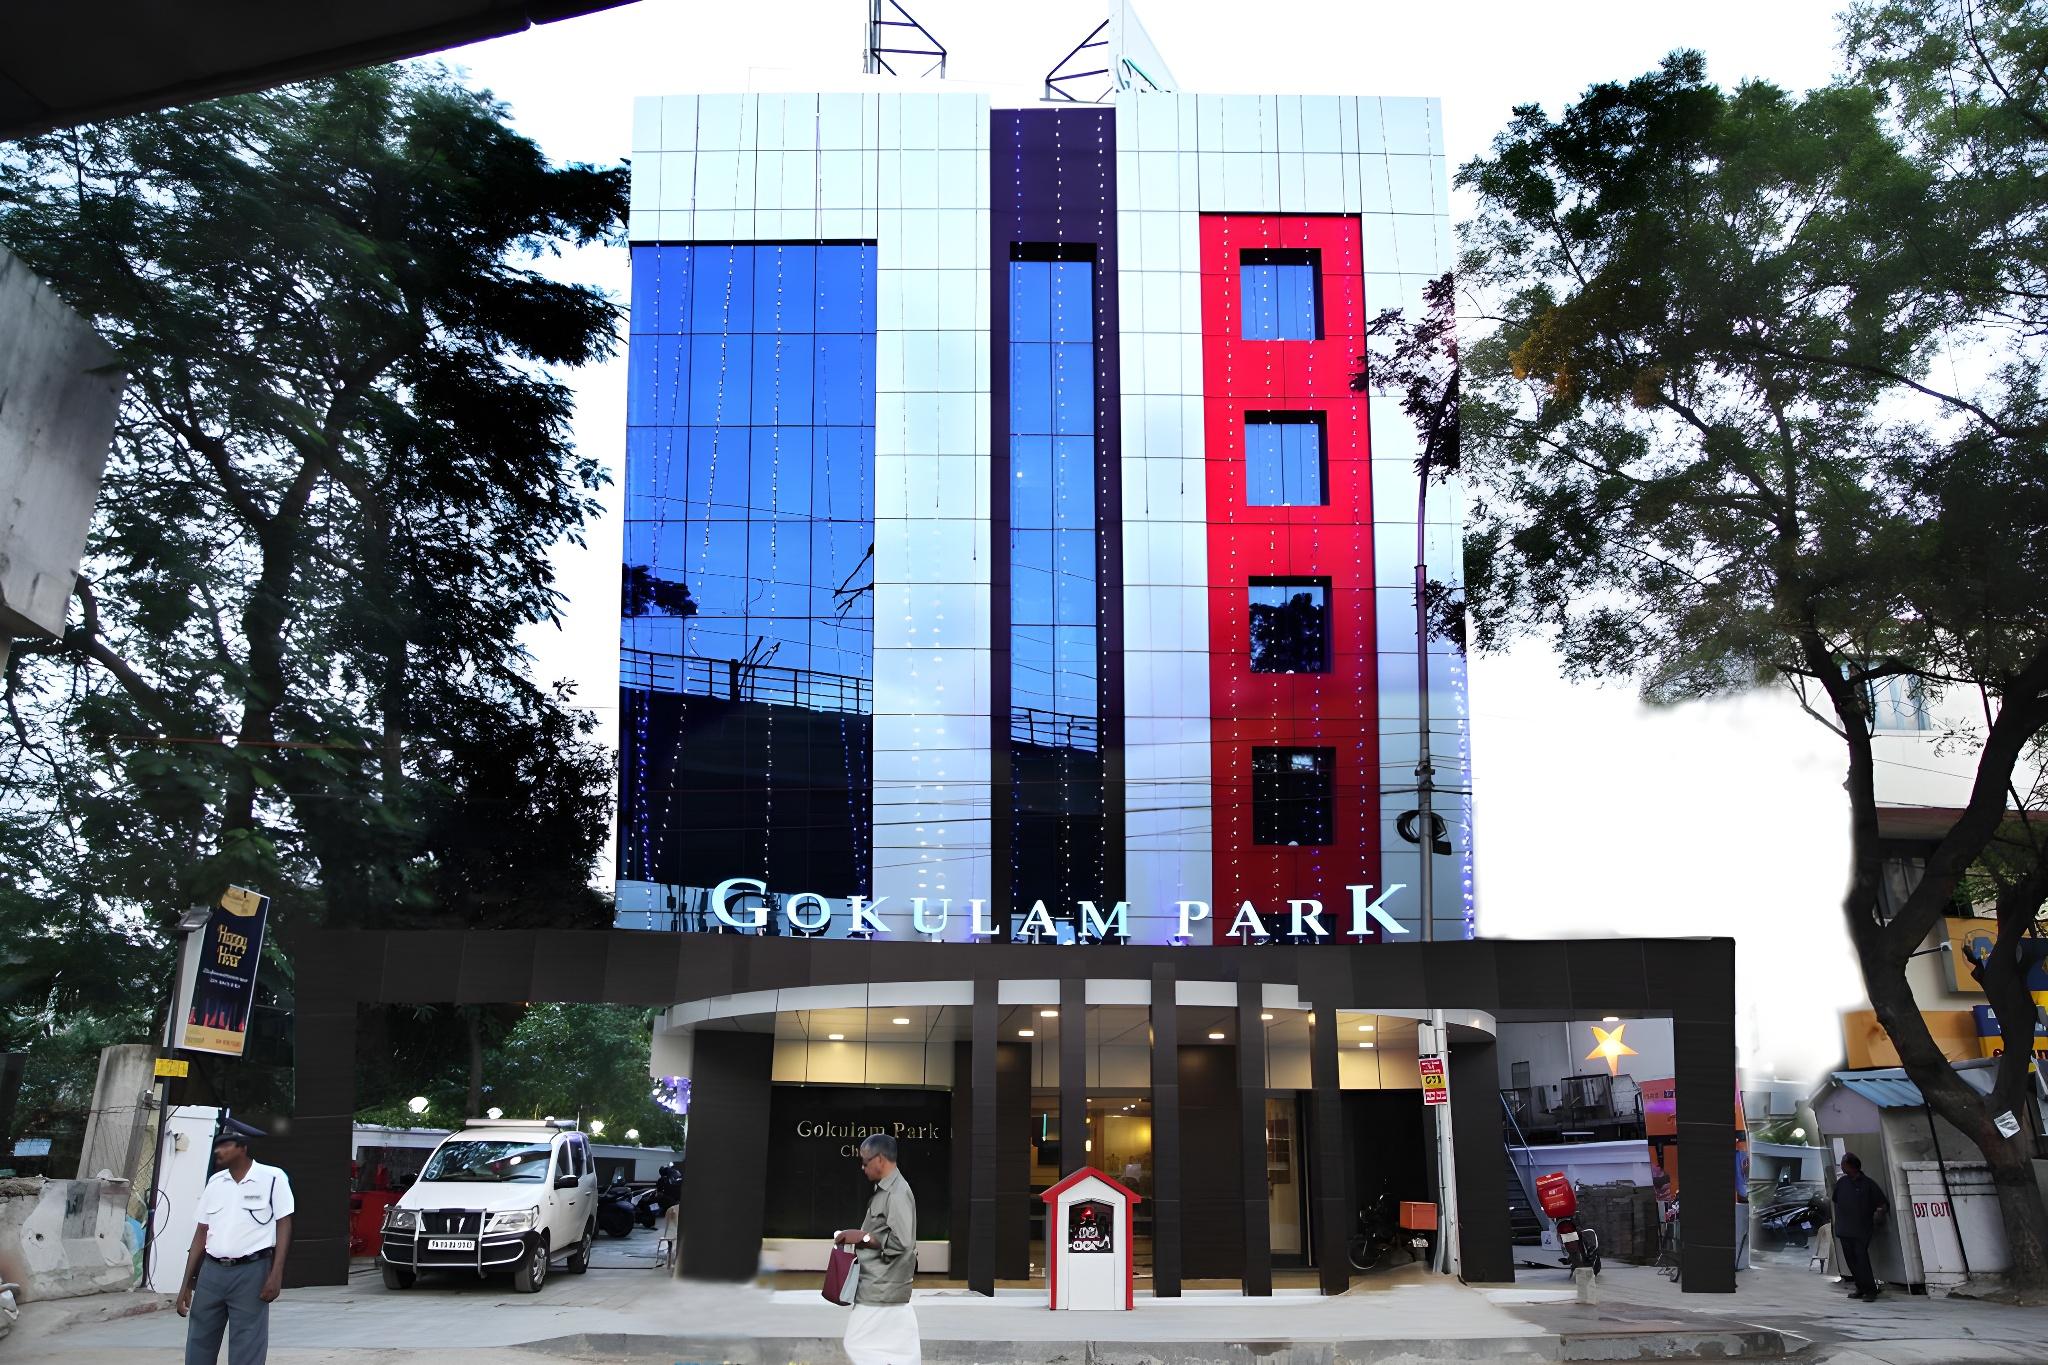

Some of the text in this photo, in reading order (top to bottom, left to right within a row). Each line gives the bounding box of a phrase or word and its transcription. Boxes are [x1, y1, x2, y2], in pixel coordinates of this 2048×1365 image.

[711, 878, 1410, 937] GOKULAM PARK
[893, 1122, 939, 1139] Park
